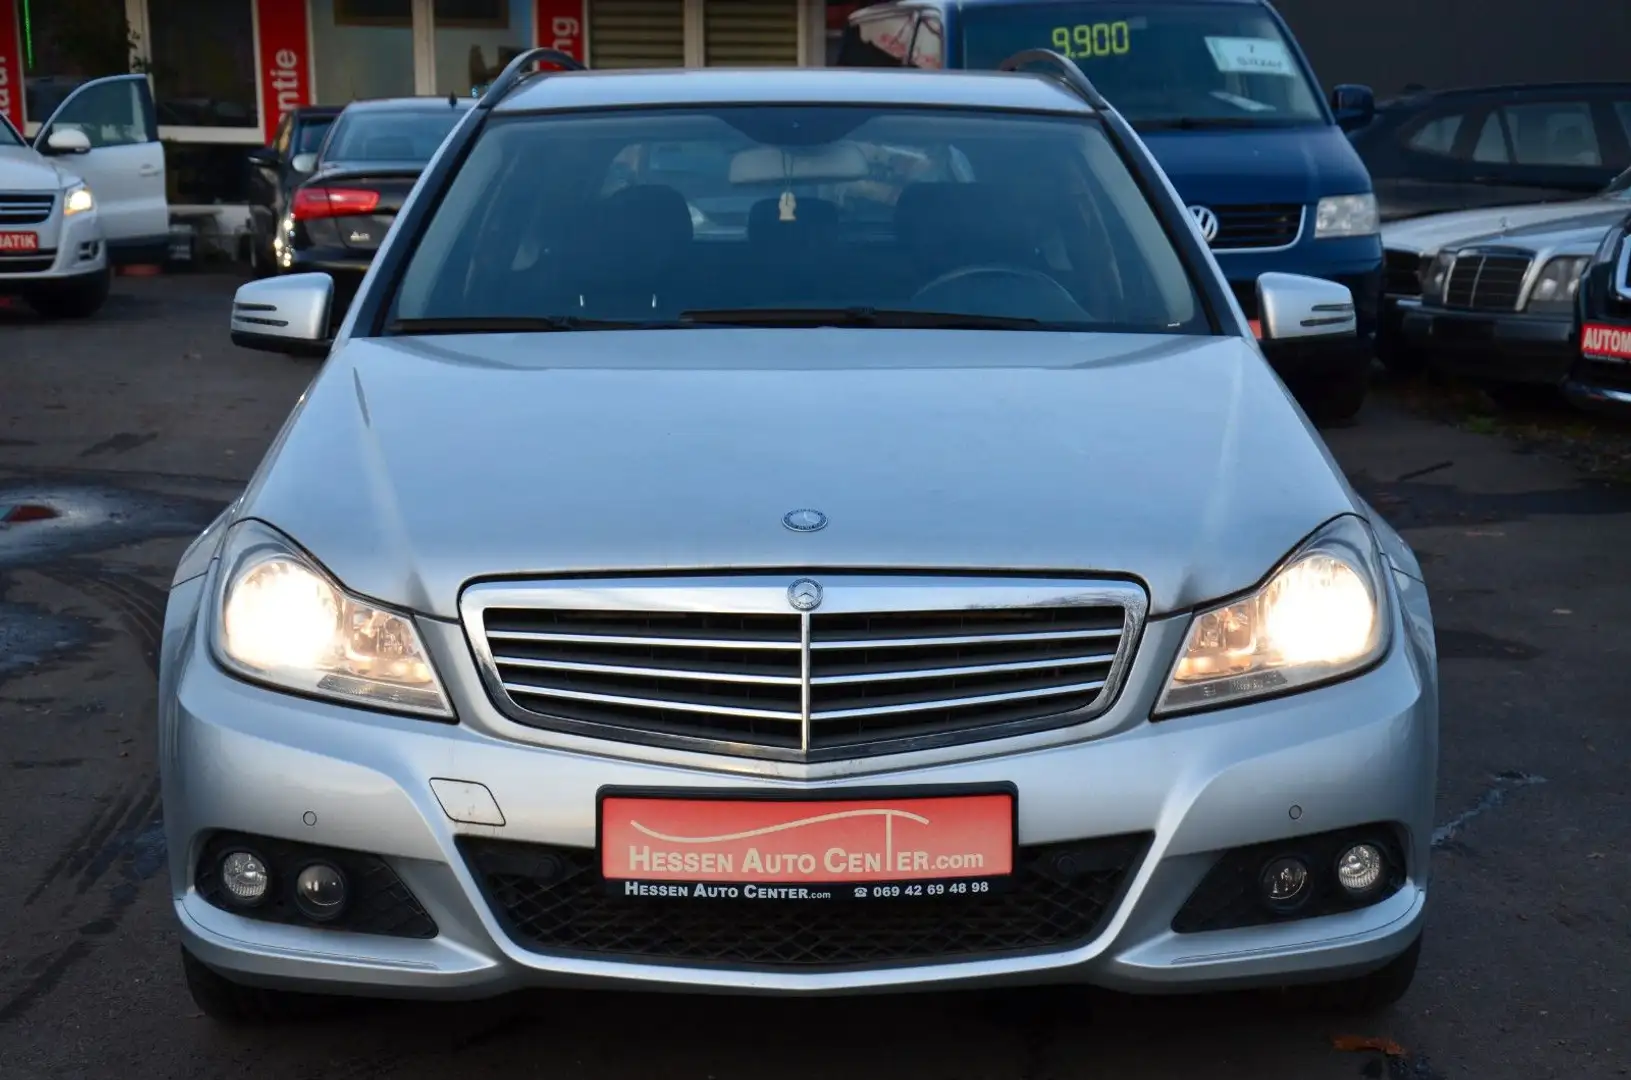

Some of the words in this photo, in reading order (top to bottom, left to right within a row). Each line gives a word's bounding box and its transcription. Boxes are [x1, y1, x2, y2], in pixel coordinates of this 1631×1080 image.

[1052, 21, 1129, 58] 9.900
[270, 49, 299, 121] ntie
[0, 234, 36, 249] ATIK
[873, 886, 900, 897] 069
[905, 885, 922, 896] 42
[927, 884, 944, 895] 69
[949, 882, 966, 894] 48
[972, 881, 989, 893] 98
